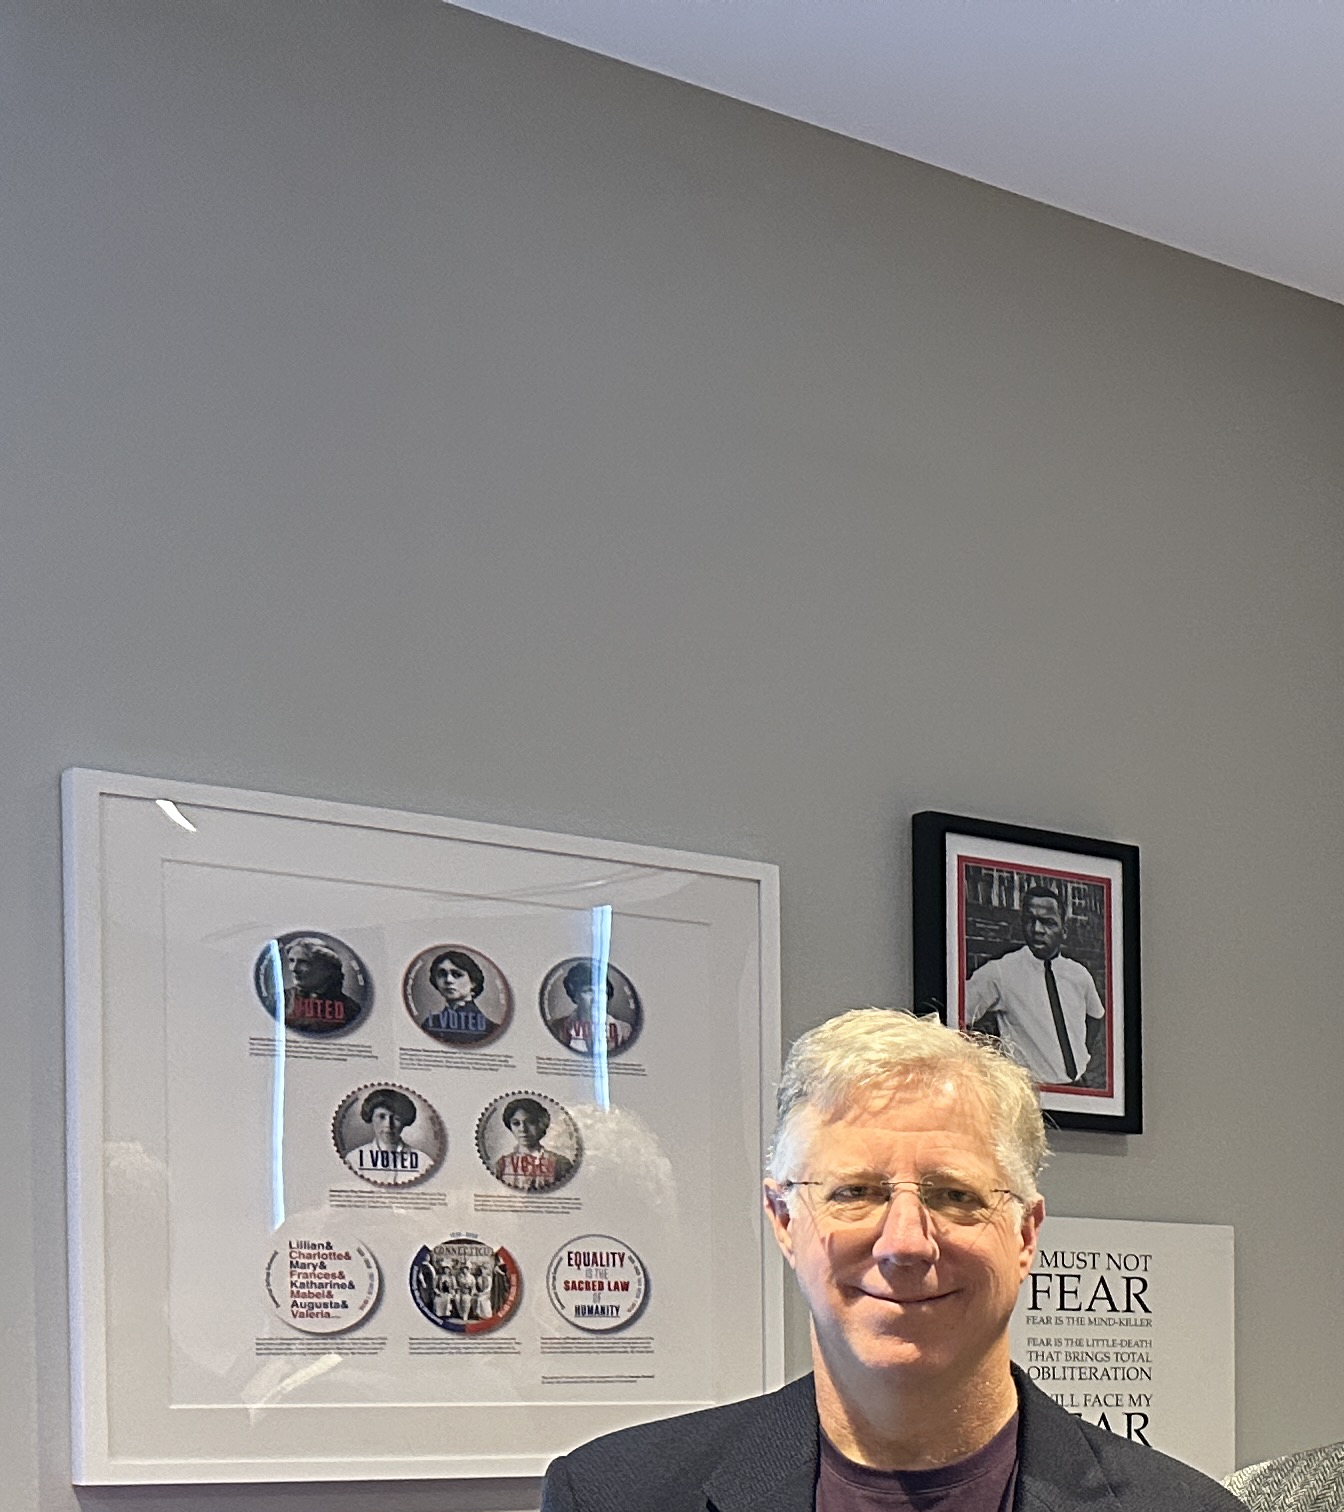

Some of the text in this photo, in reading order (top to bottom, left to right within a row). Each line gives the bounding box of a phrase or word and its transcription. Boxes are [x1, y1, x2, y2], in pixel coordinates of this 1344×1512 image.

[440, 1009, 487, 1031] VOTED
[370, 1150, 418, 1169] VOTED
[511, 1156, 556, 1176] VOTED
[289, 1250, 351, 1260] Charlotte&
[567, 1251, 626, 1270] EQUALITY
[1039, 1250, 1153, 1272] MUST NOT
[290, 1261, 327, 1271] Mary&
[290, 1271, 345, 1280] Frances&
[595, 1268, 608, 1280] THE
[563, 1280, 630, 1292] SACRED LAW
[1027, 1272, 1153, 1314] FEAR
[575, 1304, 620, 1316] HUMANITY
[1026, 1315, 1153, 1327] FEAR IS THE MIND-KILLER
[1027, 1337, 1152, 1348] FEAR IS THE LITTLE-DEATH
[1027, 1351, 1153, 1364] THAT BRINGS TOTAL
[1027, 1365, 1153, 1382] OBLITERATION
[1083, 1393, 1124, 1408] FACE
[1128, 1394, 1153, 1409] MY
